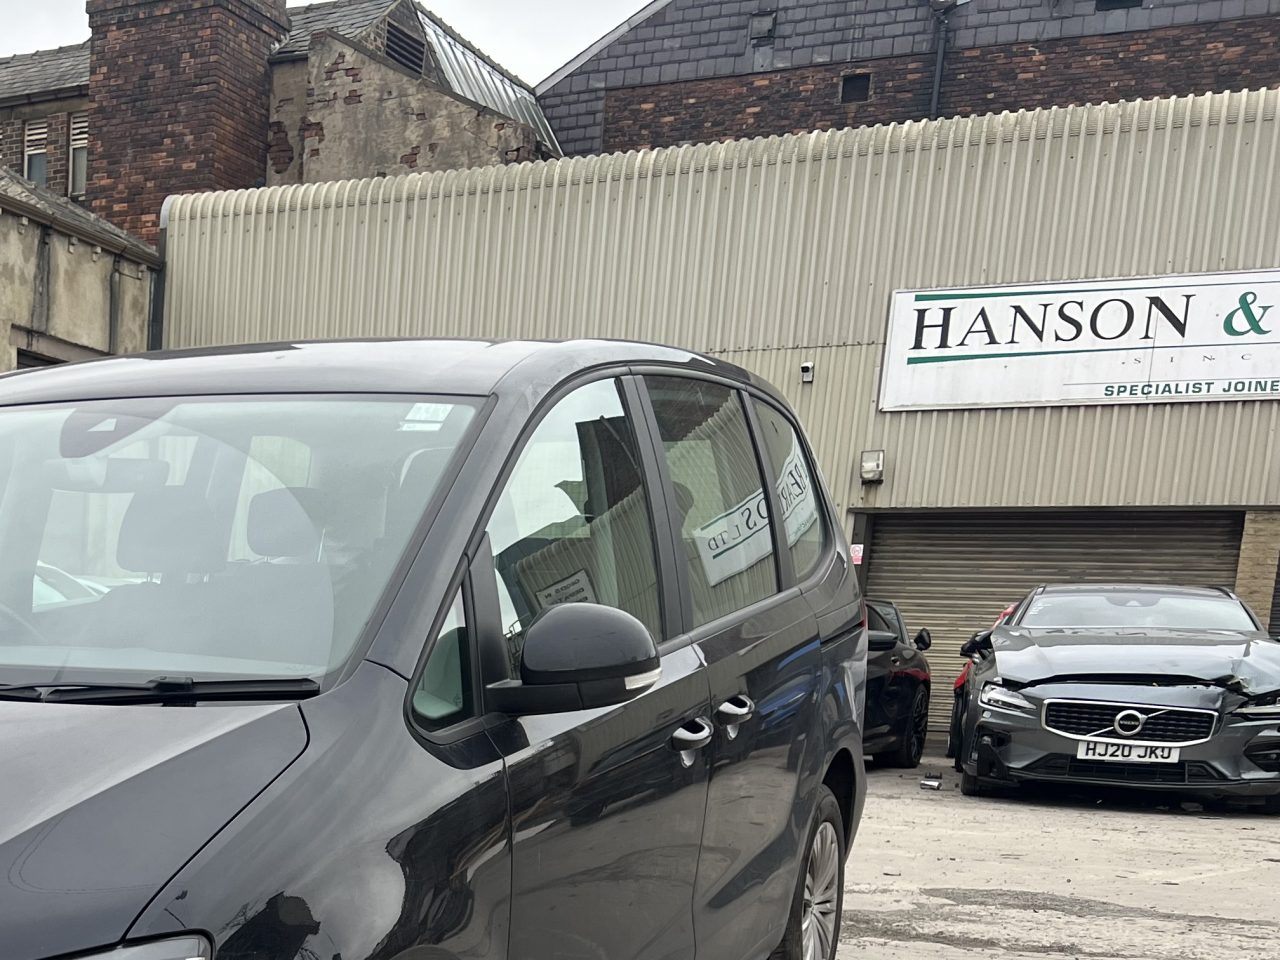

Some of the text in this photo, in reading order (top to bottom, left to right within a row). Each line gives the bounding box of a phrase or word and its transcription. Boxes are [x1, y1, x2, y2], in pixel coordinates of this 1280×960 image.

[909, 290, 1274, 351] HANSON &
[1103, 381, 1215, 397] SPECIALIST
[1084, 741, 1133, 758] HJ20
